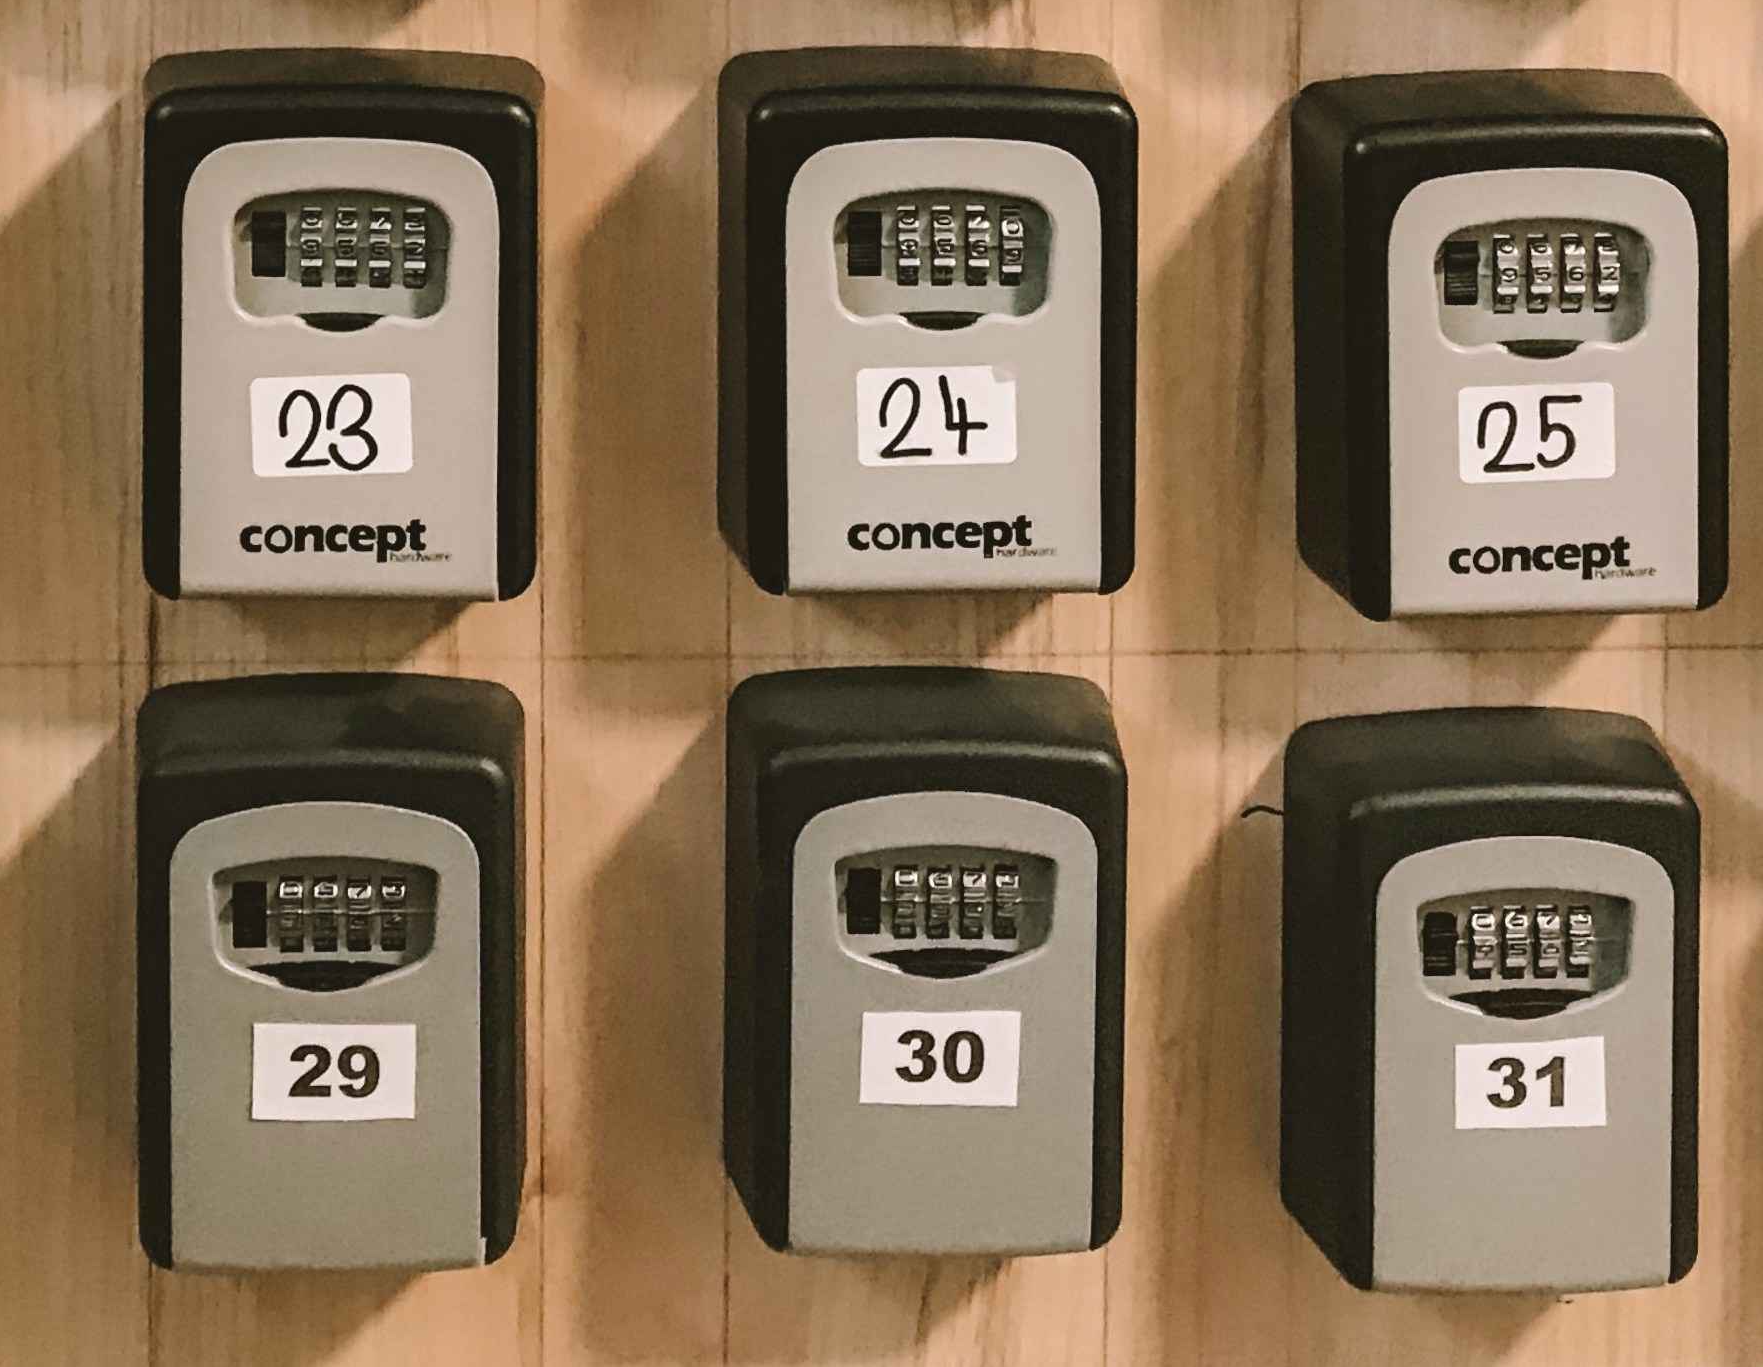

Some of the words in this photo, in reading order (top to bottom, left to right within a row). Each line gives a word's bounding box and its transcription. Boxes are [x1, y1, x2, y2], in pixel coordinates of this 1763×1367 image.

[278, 384, 379, 470] 23
[878, 374, 989, 459] 24
[1476, 394, 1583, 473] 25
[239, 518, 427, 564] concept
[847, 514, 1033, 559] concept
[1448, 535, 1631, 581] concept
[288, 1043, 380, 1099] 29
[895, 1029, 985, 1084] 30
[1486, 1055, 1565, 1109] 31
